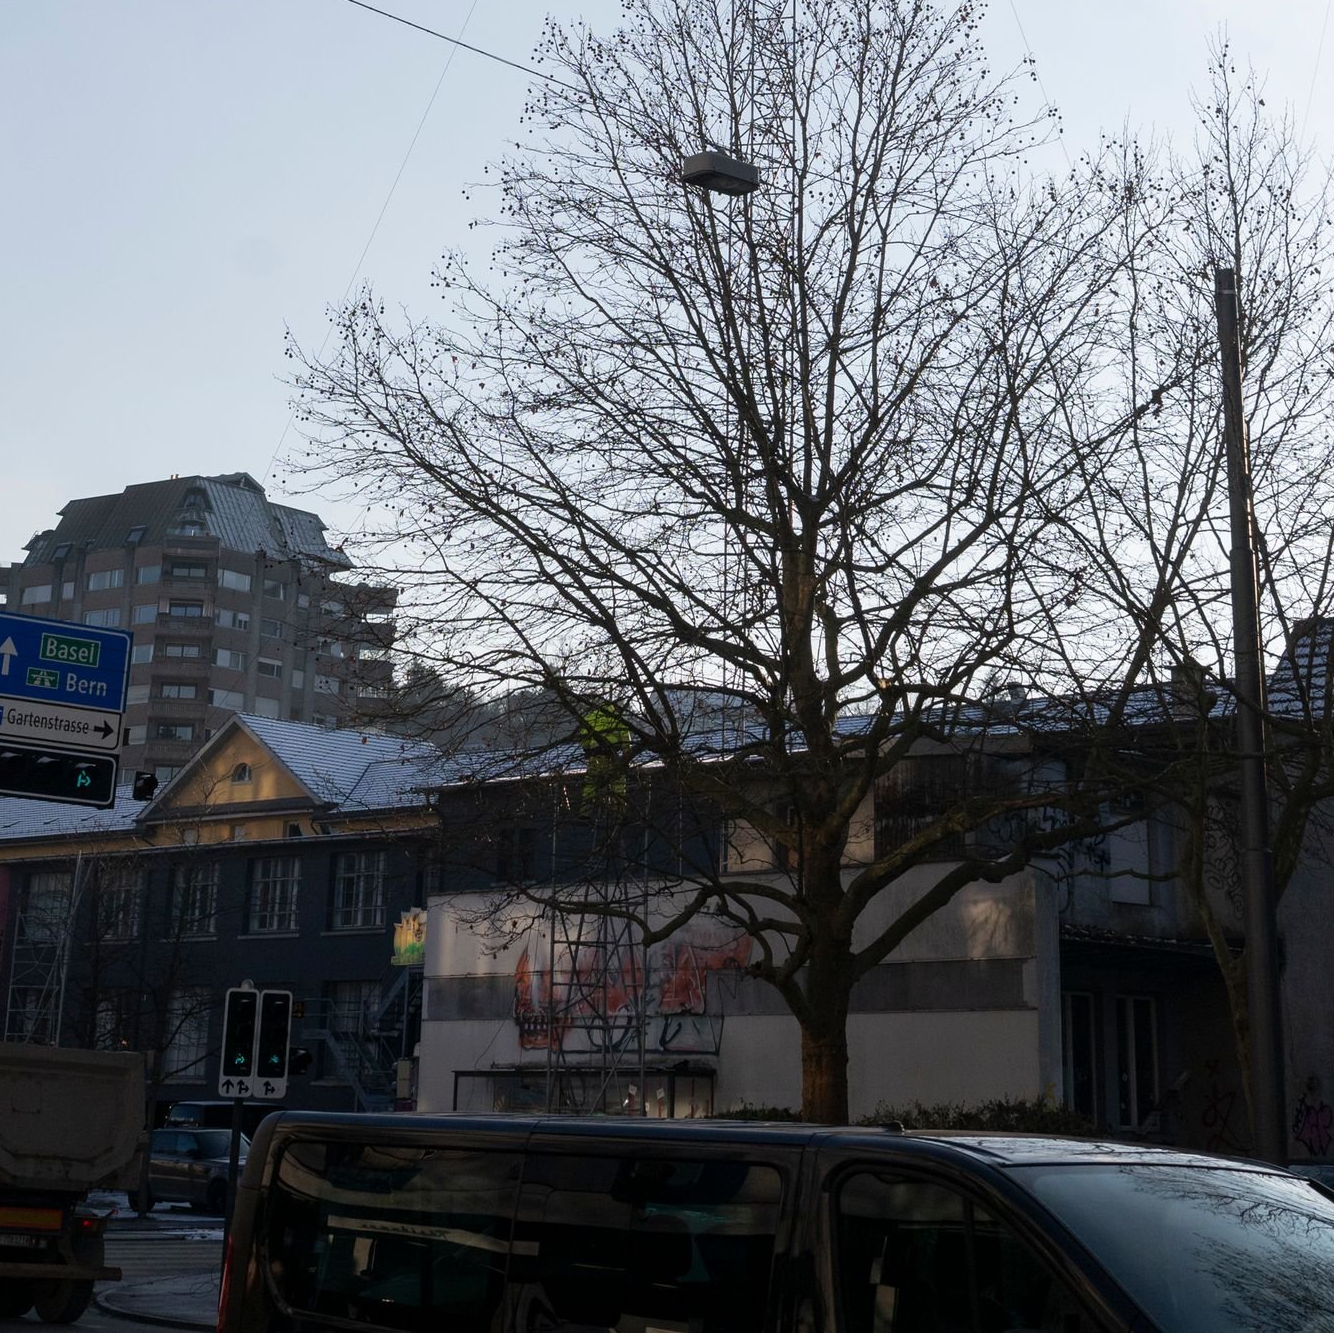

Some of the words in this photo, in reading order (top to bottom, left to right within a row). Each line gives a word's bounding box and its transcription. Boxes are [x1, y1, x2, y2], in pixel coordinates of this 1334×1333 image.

[45, 637, 96, 664] Basel
[65, 673, 107, 697] Bern
[7, 708, 89, 734] Gartenstrasse
